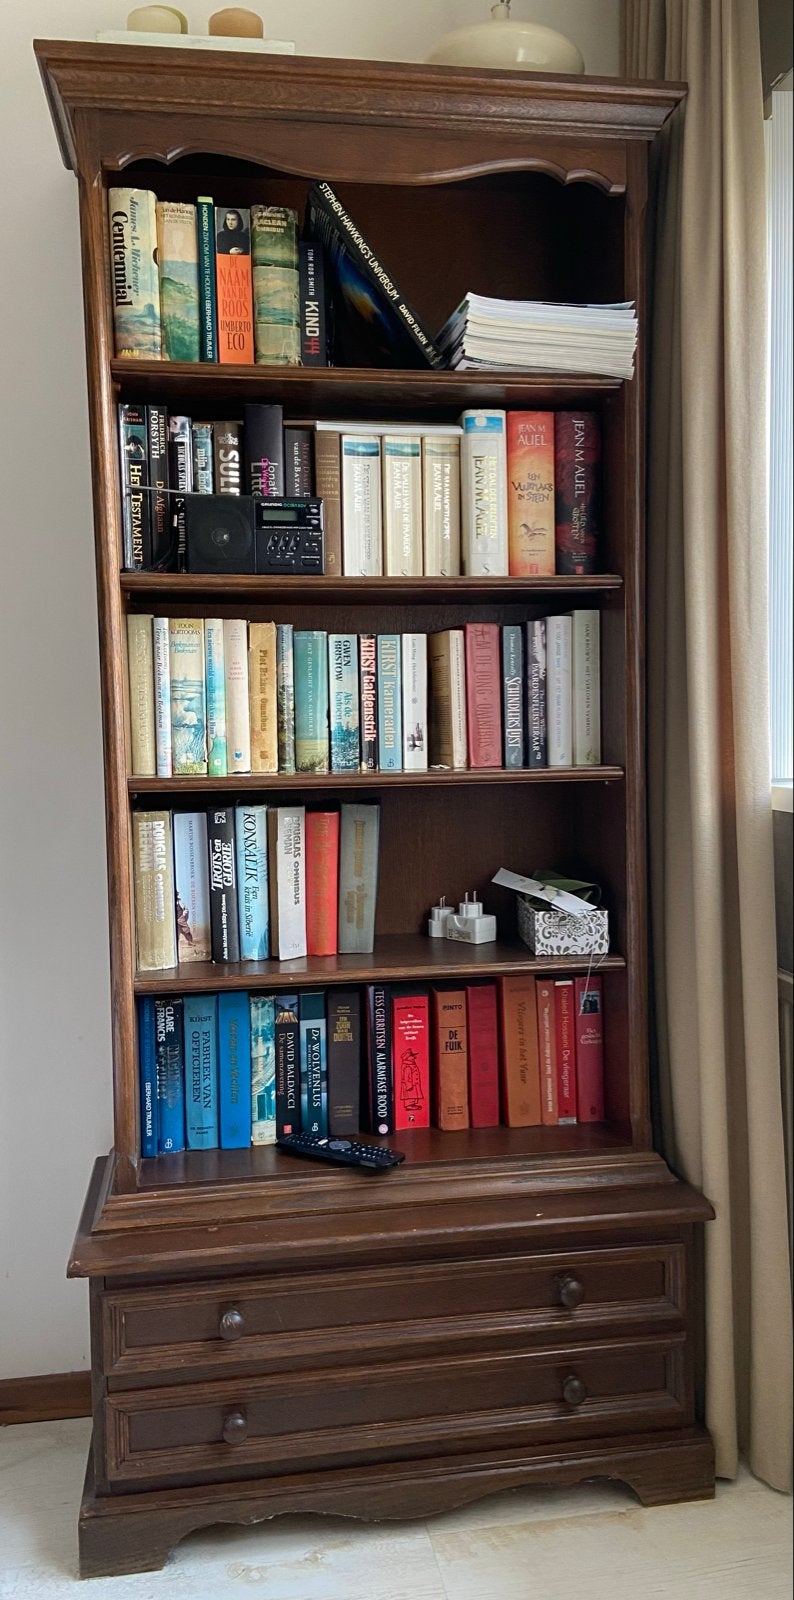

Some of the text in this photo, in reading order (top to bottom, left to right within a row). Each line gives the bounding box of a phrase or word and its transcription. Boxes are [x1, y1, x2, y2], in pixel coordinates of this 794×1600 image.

[130, 197, 139, 233] James
[112, 211, 134, 307] Centennial
[220, 268, 249, 287] NAAM
[230, 256, 237, 268] DE
[319, 182, 429, 346] STEPHEN HAWKING'S UNIVERSUM DAVID FILKIN
[222, 299, 249, 318] ROOS
[223, 287, 249, 300] VAN DE
[308, 277, 316, 296] SMITH
[205, 300, 213, 331] EBERHARD
[220, 319, 252, 333] UMBERTO
[305, 300, 320, 337] KIND
[227, 332, 245, 351] ECO
[150, 410, 160, 459] FORSYTH
[158, 414, 166, 455] FREDERICK
[518, 434, 547, 446] AUEL
[295, 456, 304, 465] de
[572, 420, 586, 499] JEAN AUEL
[352, 463, 363, 512] JEAN AUEL
[391, 461, 402, 510] JEAN AUEL
[432, 463, 442, 512] JEAN AUEL
[472, 455, 489, 540] JEAN M. AUEL
[525, 492, 550, 503] STEEN
[129, 492, 143, 562] TESTAMENT
[154, 495, 165, 534] Afghaan
[155, 627, 163, 645] Terug
[343, 640, 352, 667] GWEN
[157, 662, 165, 691] Beekman
[207, 658, 215, 676] wereld
[334, 640, 344, 682] BRISTOW
[259, 649, 268, 732] Piet Bakker Omnibus
[334, 691, 344, 720] katoen
[344, 691, 353, 718] Als de
[361, 637, 377, 742] KIRST Galgenstrik
[381, 640, 398, 749] KIRST Kameraden
[474, 654, 494, 751] DE JONG OMNIBUS
[505, 676, 522, 729] SCHINDLERS
[531, 662, 541, 752] PAARDENFLUISTERAAR
[158, 700, 166, 729] Beekman
[139, 821, 153, 872] REEMAN
[153, 820, 167, 872] DOUGLAS
[243, 812, 259, 883] KONSALIK
[292, 815, 301, 859] DOUGLAS
[211, 839, 222, 892] TROTS en
[223, 843, 233, 887] GLORIE
[154, 873, 165, 922] OMNIBUS
[244, 886, 254, 937] kruis in Siberië
[250, 886, 260, 900] Een
[157, 1007, 166, 1042] FRANCIS
[165, 1006, 175, 1033] CLARE
[189, 1015, 212, 1023] KIRST
[448, 1029, 459, 1040] DE
[278, 1033, 286, 1096] De samenzwering
[375, 990, 388, 1118] TESS GERRITSEN ALARMFASE ROOD
[445, 1041, 463, 1051] FUIK
[517, 1002, 529, 1084] Vliegers in het Vuur
[561, 988, 570, 1098] Khaled Hosseini De vliegeraar
[192, 1031, 201, 1104] OFFICIEREN
[202, 1031, 212, 1109] FABRIEK VAN
[287, 1032, 296, 1109] DAVID BALDACCI
[311, 1029, 321, 1108] De WOLVENLUS
[145, 1111, 153, 1137] TRUMLER
